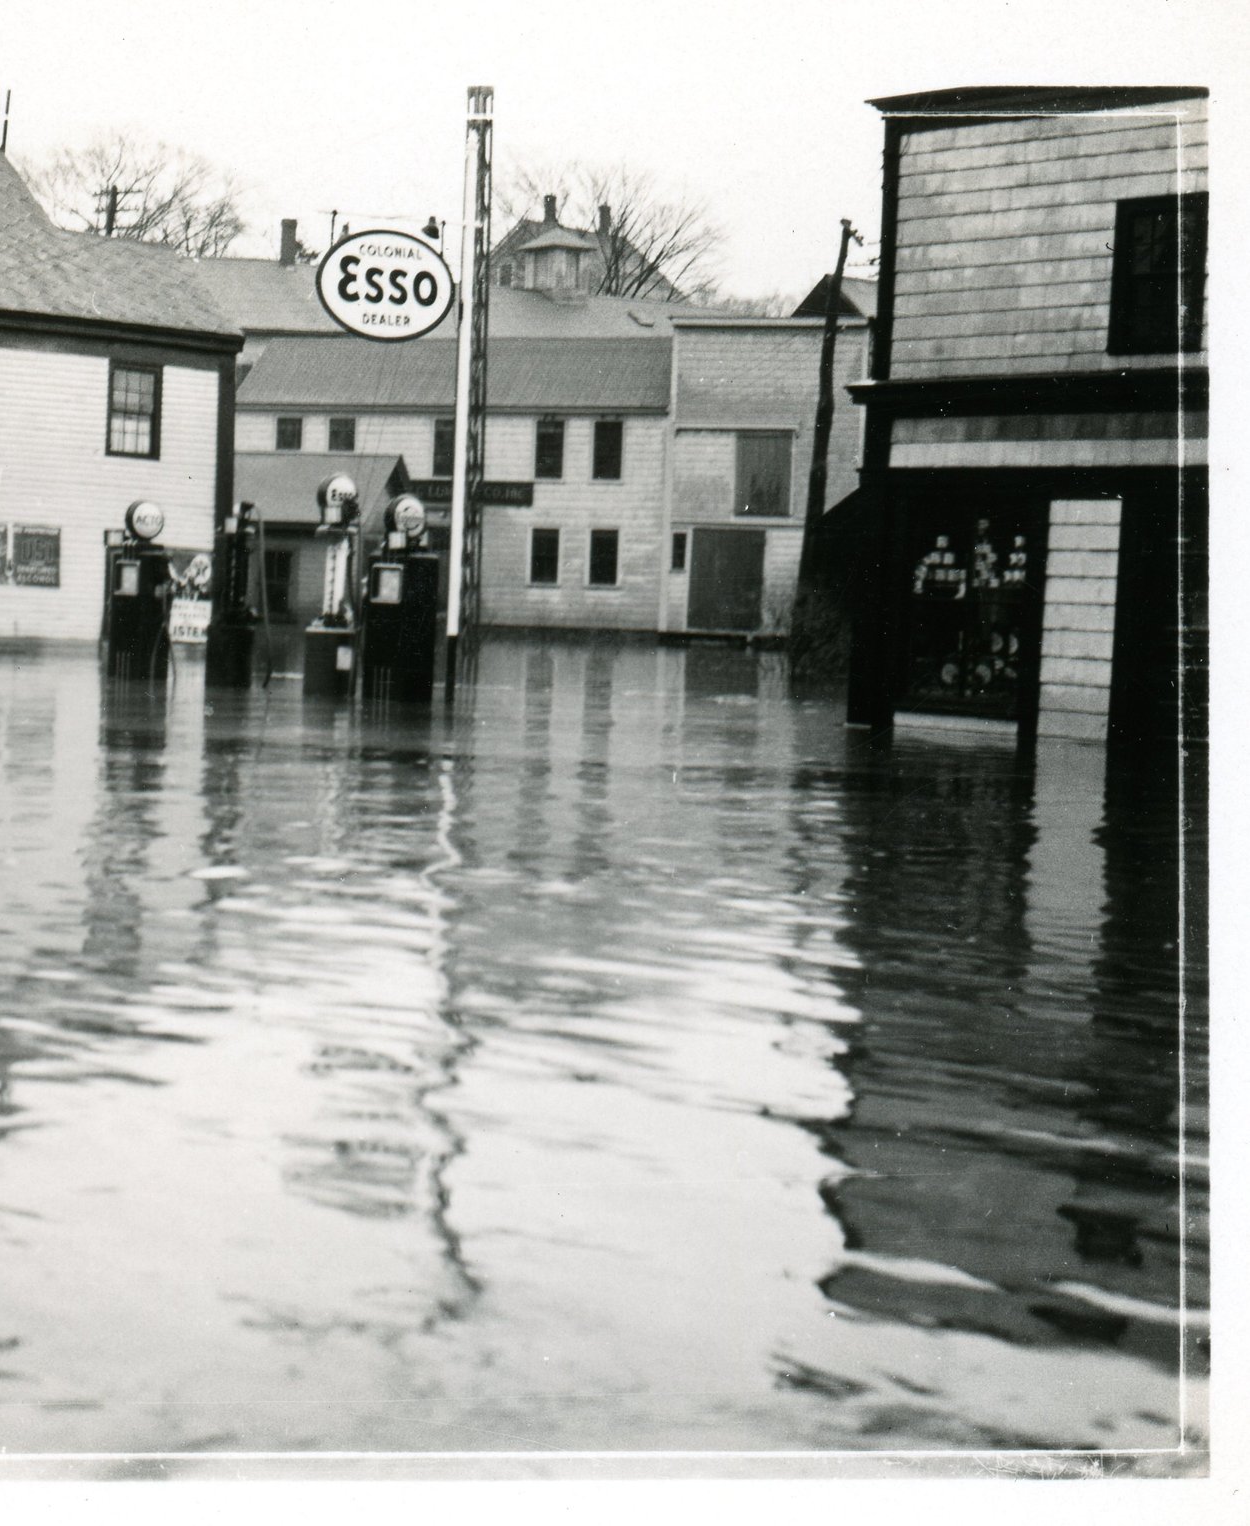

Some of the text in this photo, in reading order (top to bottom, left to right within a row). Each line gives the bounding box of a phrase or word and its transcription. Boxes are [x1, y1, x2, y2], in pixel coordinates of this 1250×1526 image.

[359, 243, 423, 261] COLONIAL
[362, 312, 411, 328] DEALER
[16, 574, 56, 585] ALCOHOL
